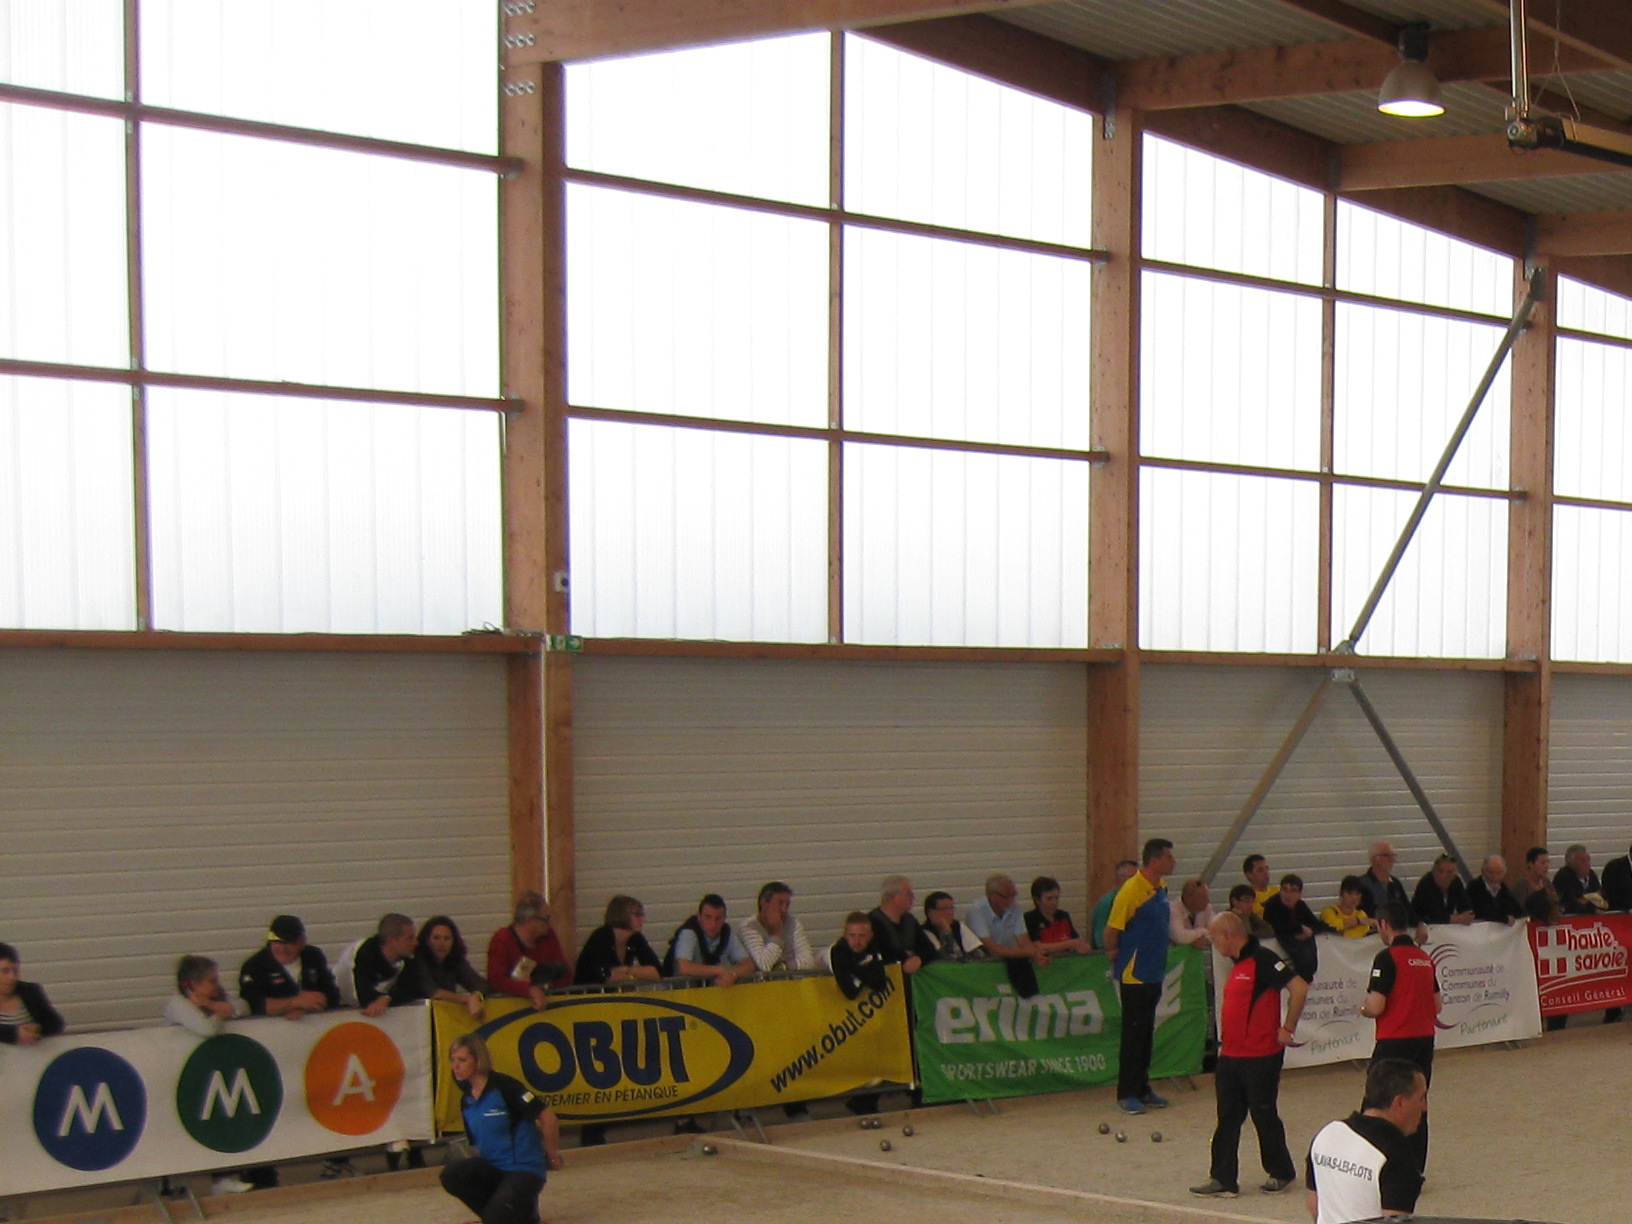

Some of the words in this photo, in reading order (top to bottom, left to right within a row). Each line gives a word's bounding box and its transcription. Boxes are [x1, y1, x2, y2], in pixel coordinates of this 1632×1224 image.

[1574, 947, 1626, 971] savoie
[1541, 993, 1580, 1007] Conseil
[1584, 987, 1626, 1001] Général
[934, 983, 1105, 1044] erima
[517, 1015, 691, 1093] OBUT
[940, 1058, 1038, 1082] SPORTSWEAR
[1040, 1056, 1075, 1075] SINCE
[1076, 1053, 1107, 1073] 1900
[540, 1092, 591, 1106] REMIER
[594, 1090, 612, 1104] EN
